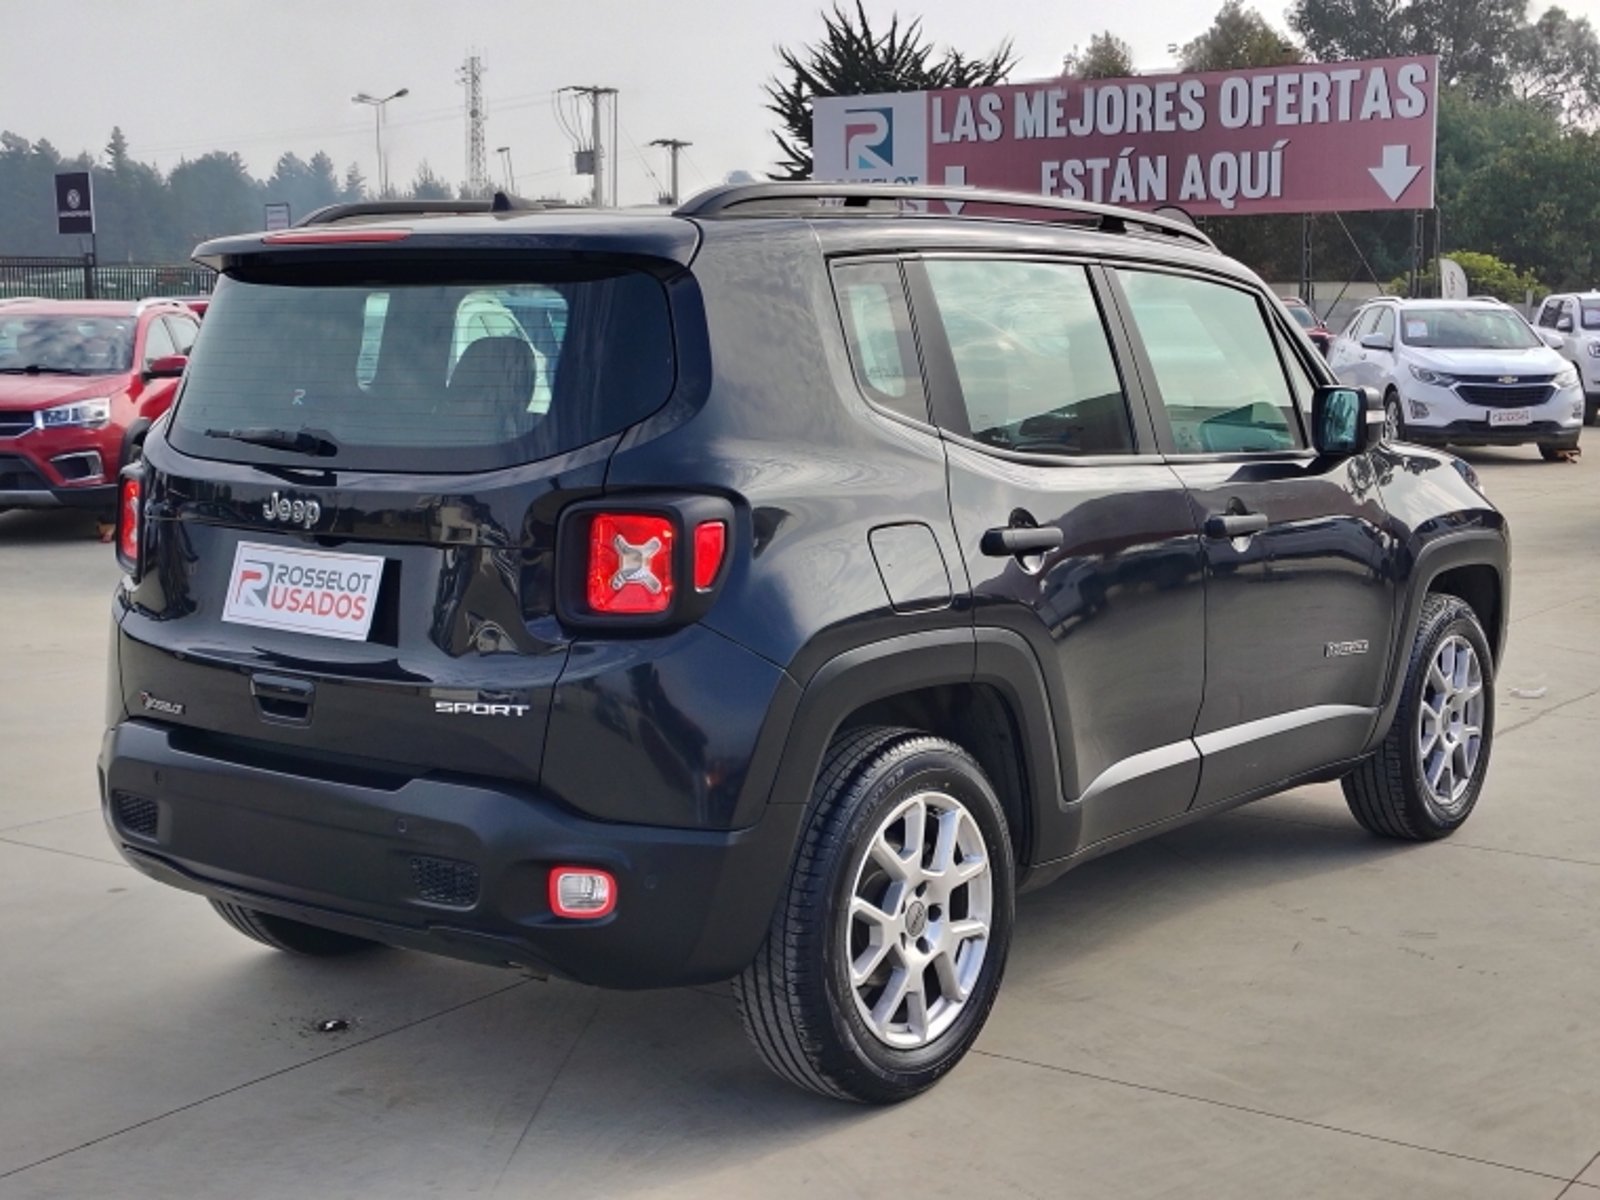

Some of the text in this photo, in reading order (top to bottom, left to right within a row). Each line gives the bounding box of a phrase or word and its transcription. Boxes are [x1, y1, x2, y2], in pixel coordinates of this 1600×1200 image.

[932, 63, 1428, 144] LAS MEJORES OFERTAS
[1041, 138, 1290, 209] ESTÁN AQUÍ
[262, 491, 321, 529] Jeep
[275, 564, 372, 593] ROSSELOT
[270, 586, 367, 620] USADOS
[435, 701, 530, 717] SPORT
